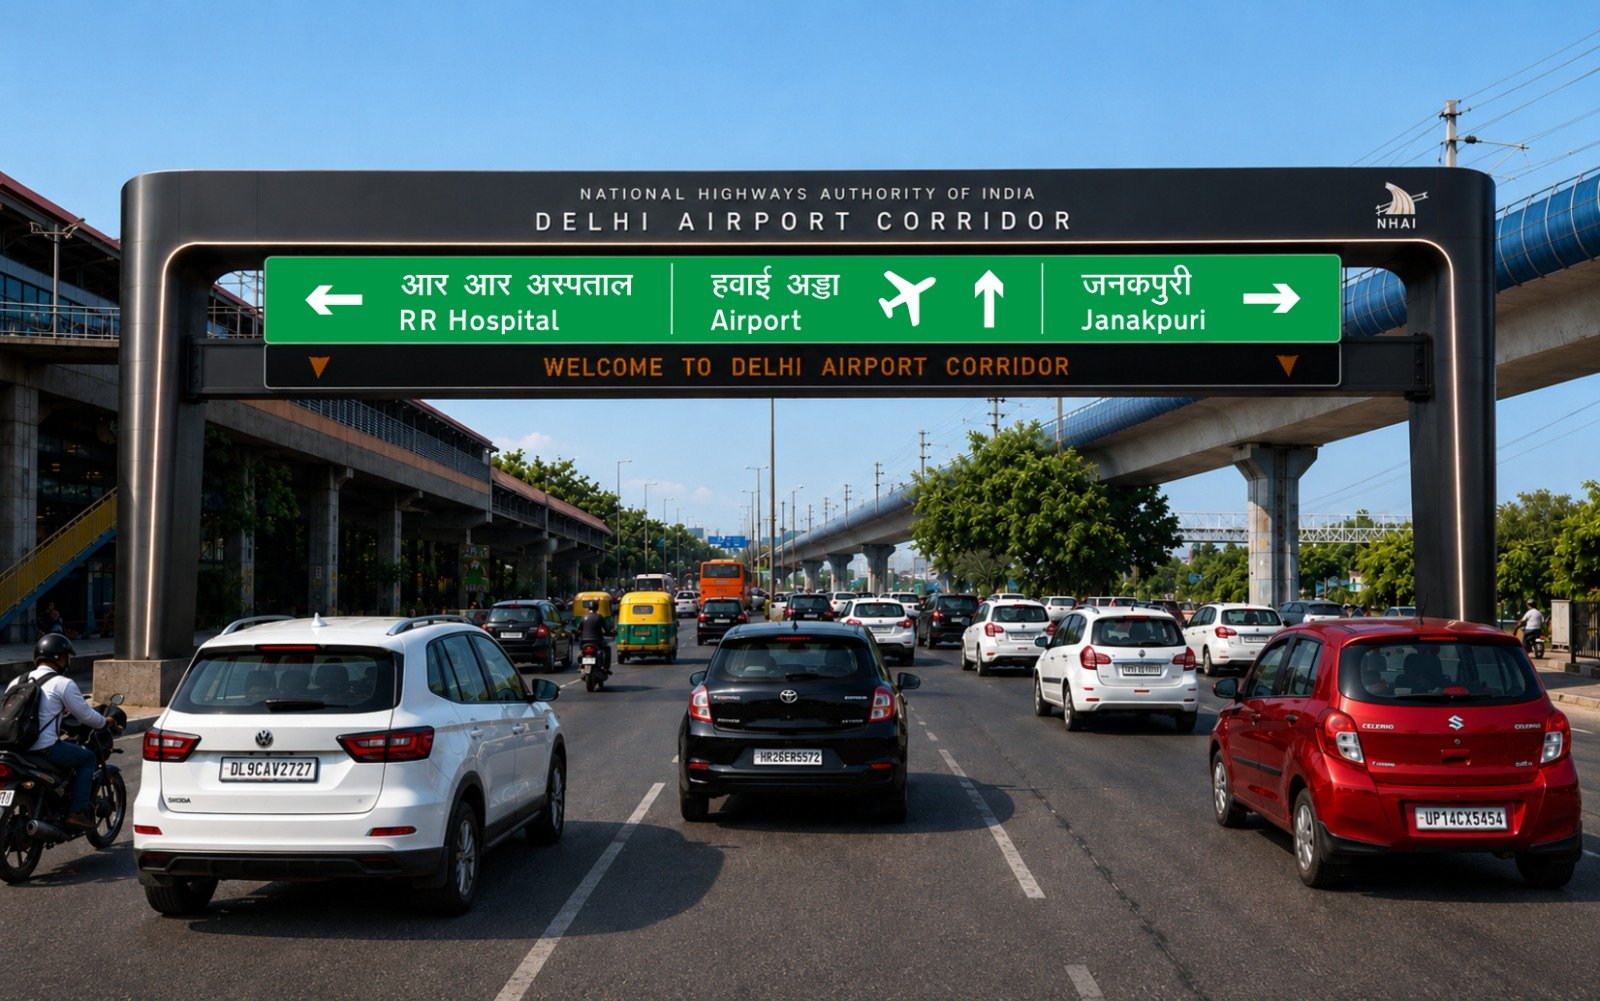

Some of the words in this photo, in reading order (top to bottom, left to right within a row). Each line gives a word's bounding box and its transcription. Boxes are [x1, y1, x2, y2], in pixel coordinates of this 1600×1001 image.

[579, 187, 685, 201] NATIONAL
[698, 187, 808, 201] HIGHWAYS
[819, 187, 936, 201] AUTHORITY
[947, 187, 970, 200] OF
[982, 187, 1035, 200] INDIA
[535, 211, 649, 232] DELHI
[677, 211, 850, 231] AIRPORT
[876, 210, 1071, 231] CORRIDOR
[1377, 217, 1416, 229] NHAI
[401, 273, 450, 297] आर
[463, 273, 512, 297] आर
[526, 273, 634, 297] अस्पताल
[710, 266, 772, 301] हवाई
[786, 273, 841, 300] अड्डा
[1080, 264, 1193, 306] जनकपुरी
[400, 309, 437, 331] RR
[449, 308, 560, 335] Hospital
[710, 308, 802, 335] Airport
[1081, 308, 1206, 335] Janakpuri
[543, 357, 663, 377] WELCOME
[682, 357, 712, 377] TO
[732, 357, 801, 377] DELHI
[821, 356, 927, 376] AIRPORT
[946, 356, 1070, 376] CORRIDOR
[760, 750, 820, 763] HR26ER5572
[230, 762, 312, 776] DL9CAV2727
[1424, 811, 1504, 827] UP14CX5454
